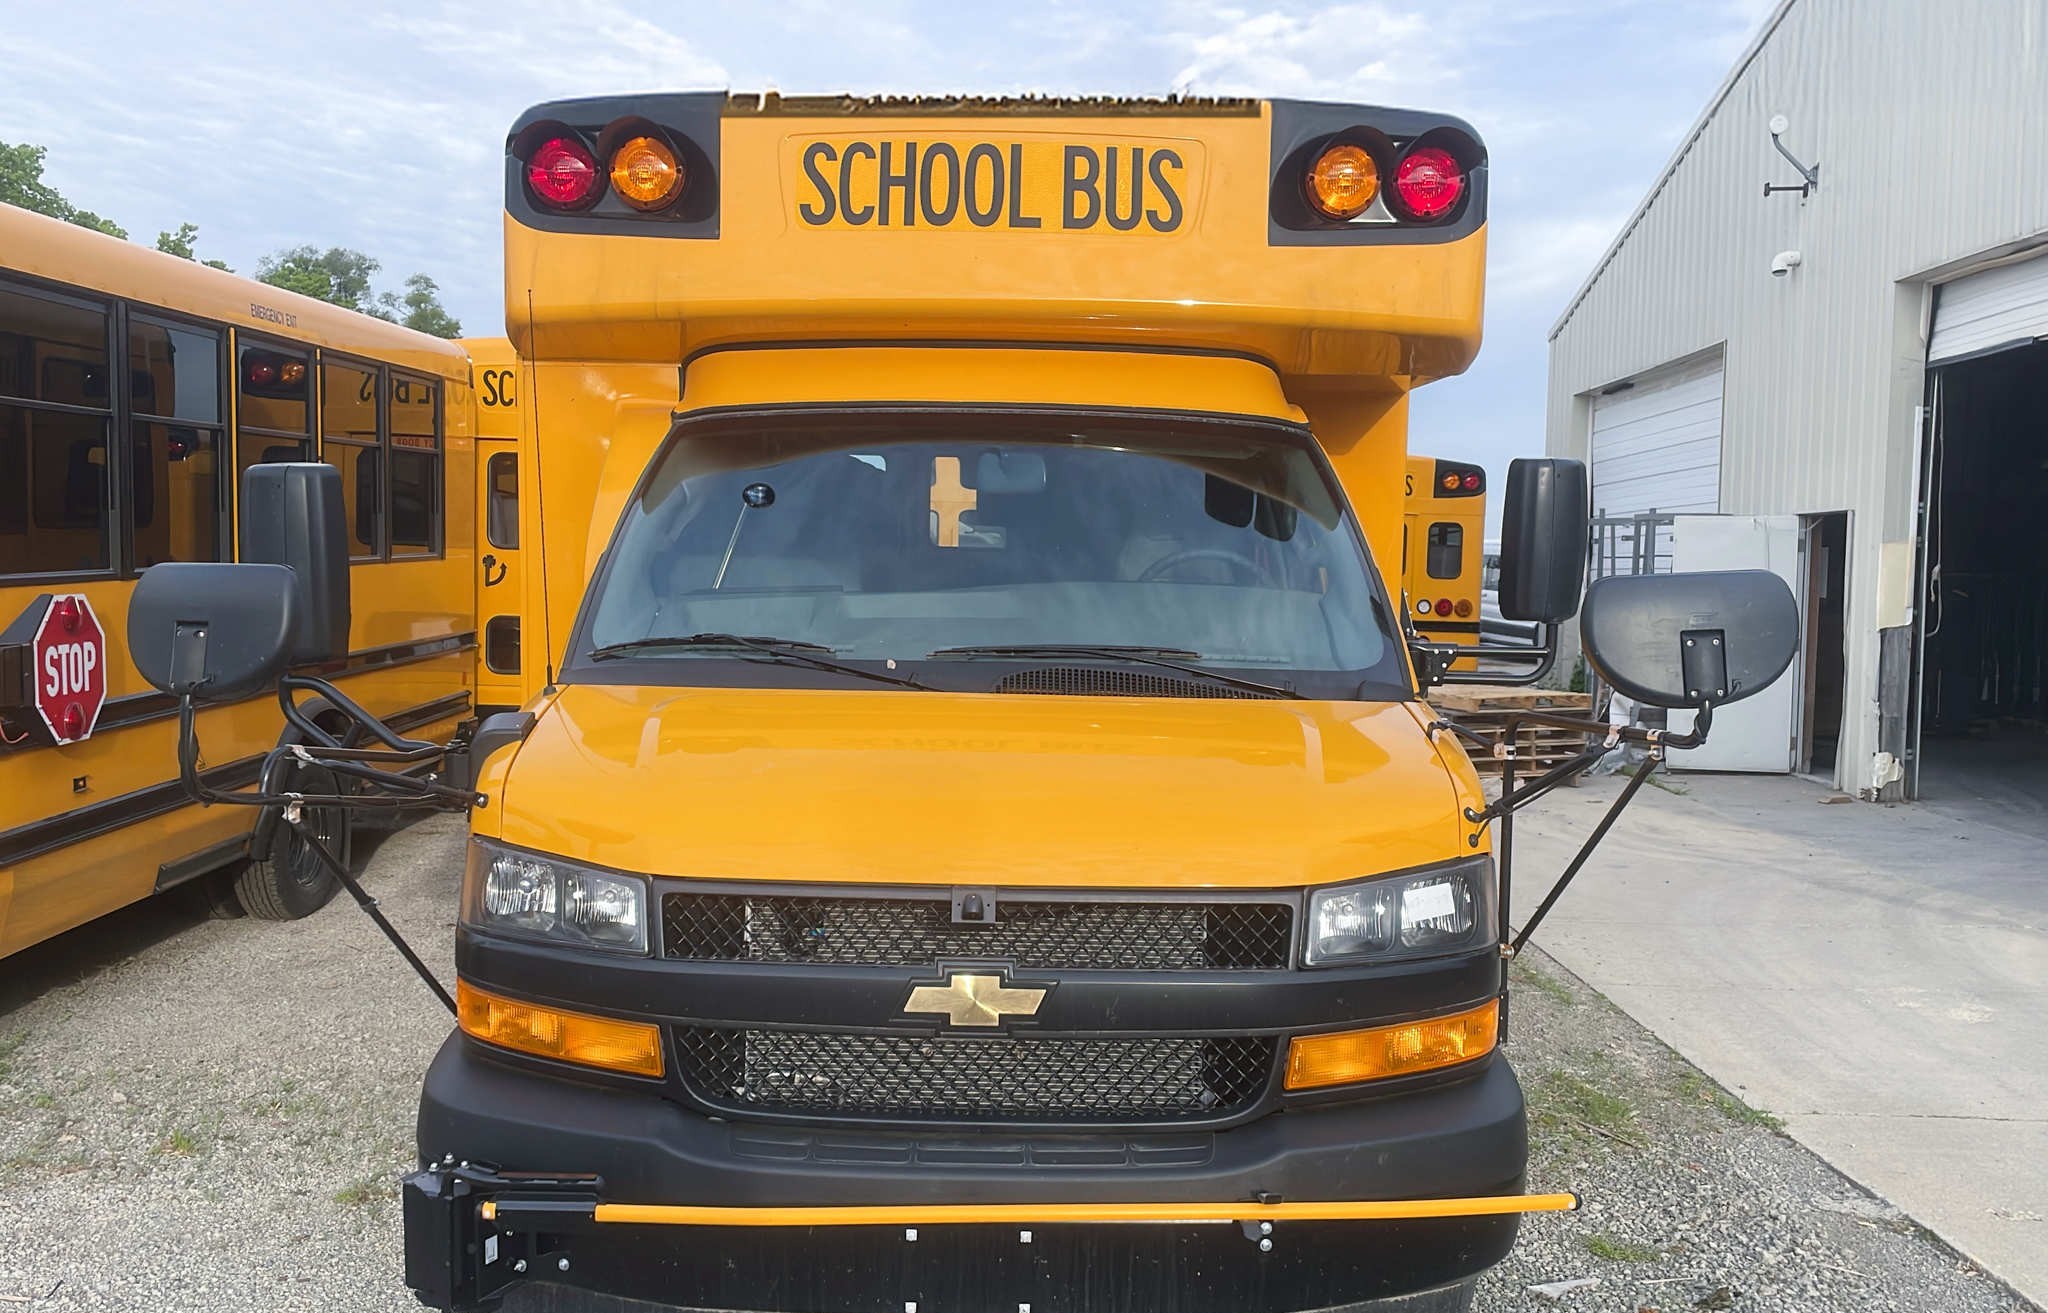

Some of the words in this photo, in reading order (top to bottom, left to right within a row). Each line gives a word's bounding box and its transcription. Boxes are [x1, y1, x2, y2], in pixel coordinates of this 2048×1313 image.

[799, 141, 1042, 229] SCHOOL
[1062, 144, 1184, 233] BUS
[45, 640, 97, 698] STOP
